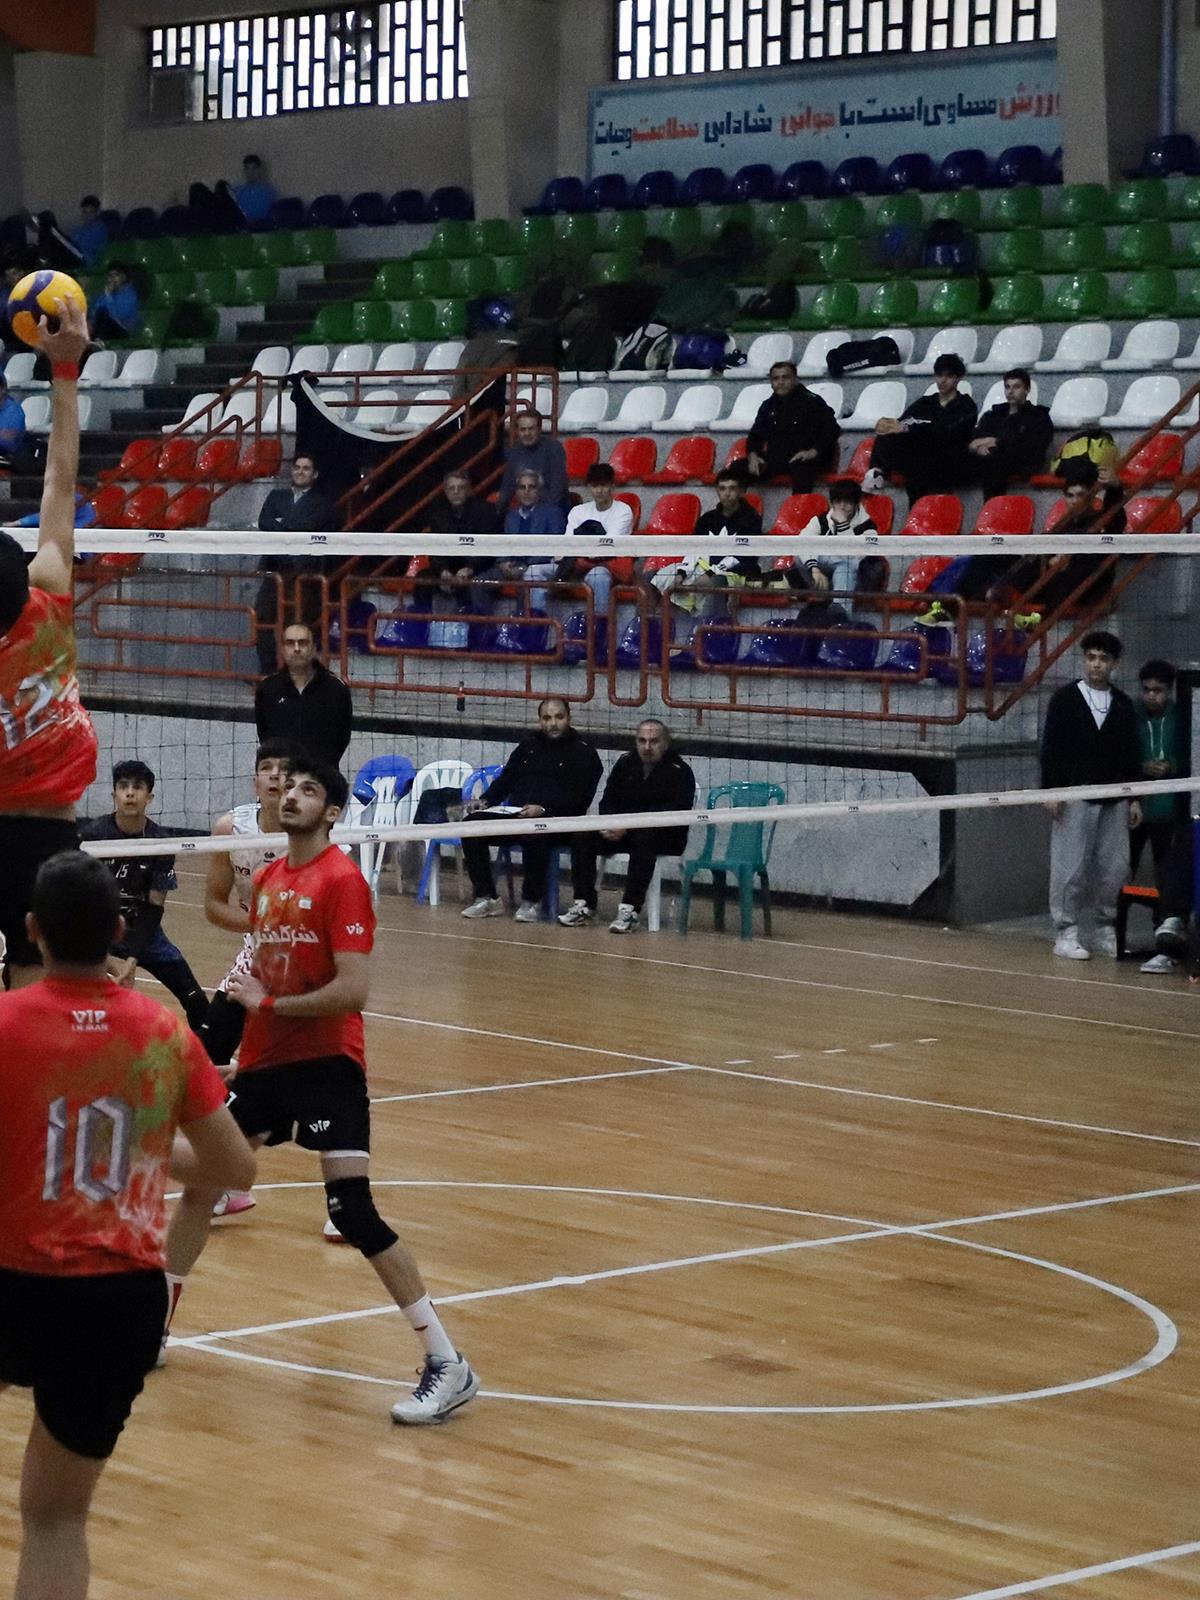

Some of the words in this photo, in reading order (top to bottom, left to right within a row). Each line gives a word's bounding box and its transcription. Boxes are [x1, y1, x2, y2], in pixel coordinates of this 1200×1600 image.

[704, 103, 772, 148] شادابی
[839, 102, 856, 139] با
[857, 96, 923, 125] است
[923, 92, 997, 127] مساوی
[234, 864, 251, 876] IVB
[72, 1009, 106, 1024] VIP
[42, 1096, 132, 1201] 10
